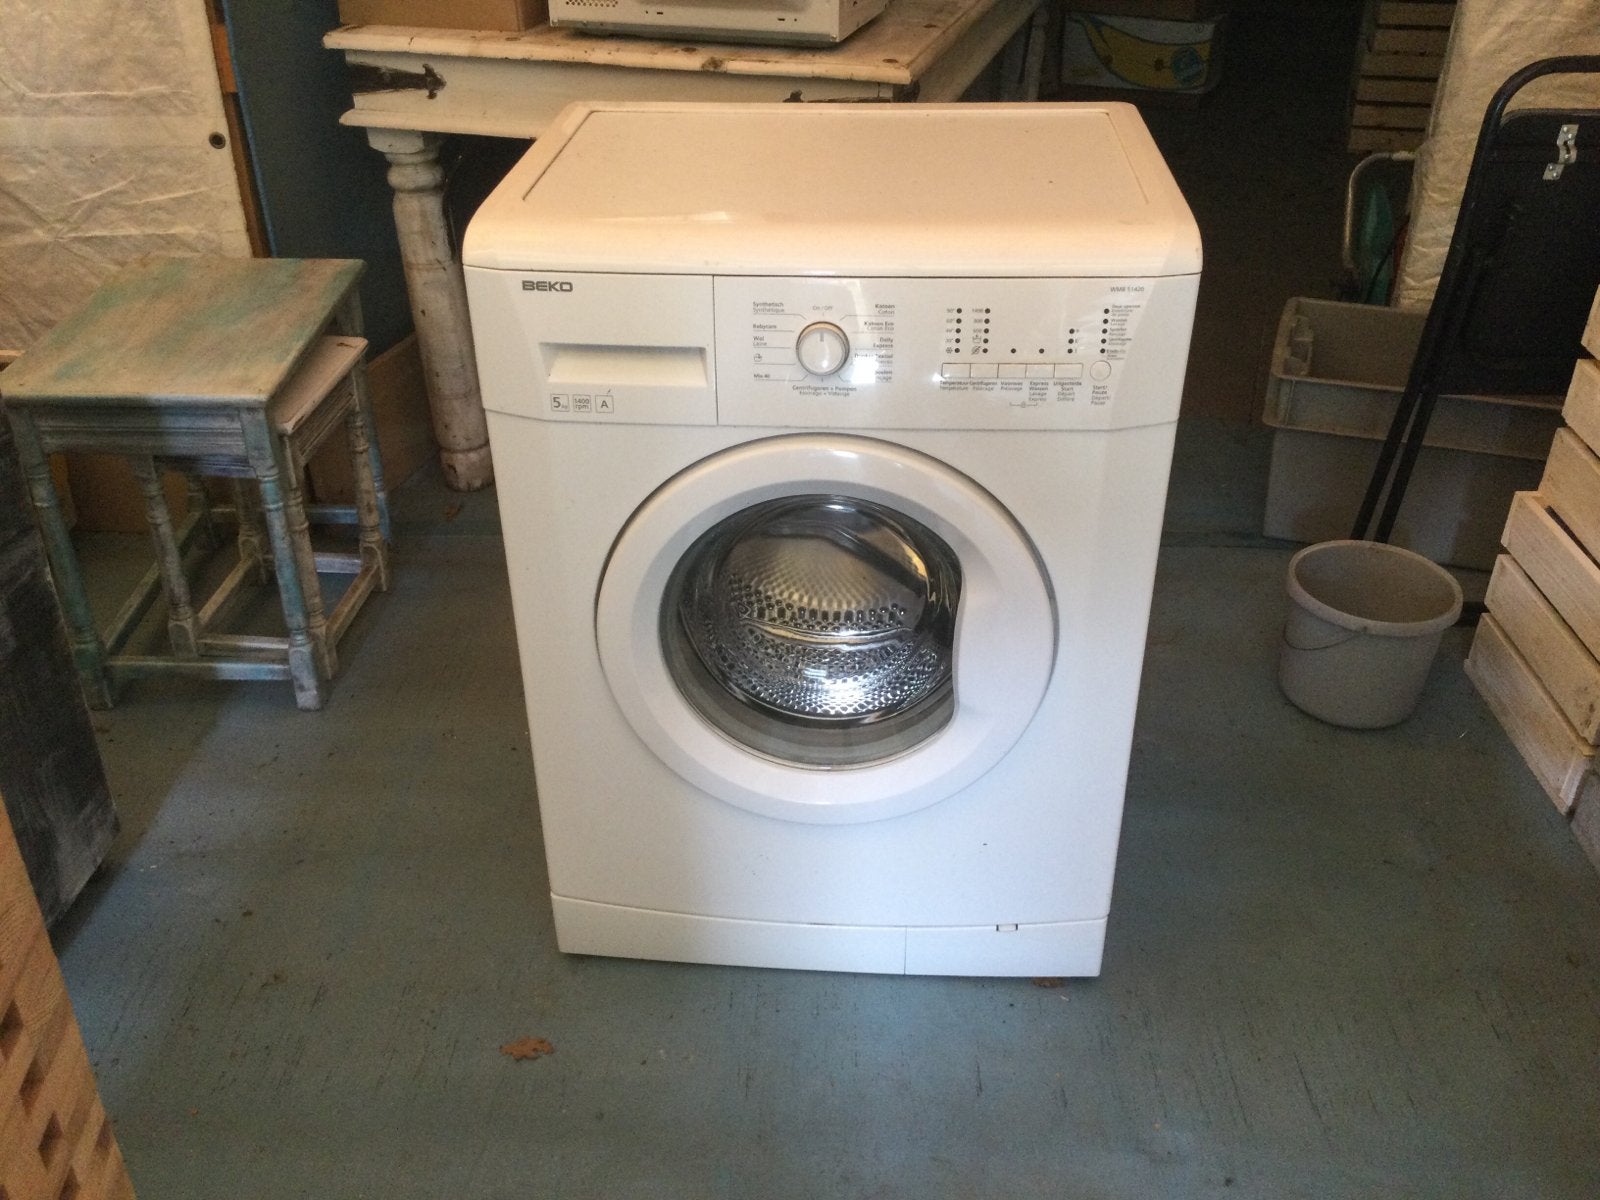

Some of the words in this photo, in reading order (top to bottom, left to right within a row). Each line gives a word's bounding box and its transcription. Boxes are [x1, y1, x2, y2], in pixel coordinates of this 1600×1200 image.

[522, 280, 574, 292] BEKO
[553, 396, 561, 408] 5
[600, 400, 609, 409] A
